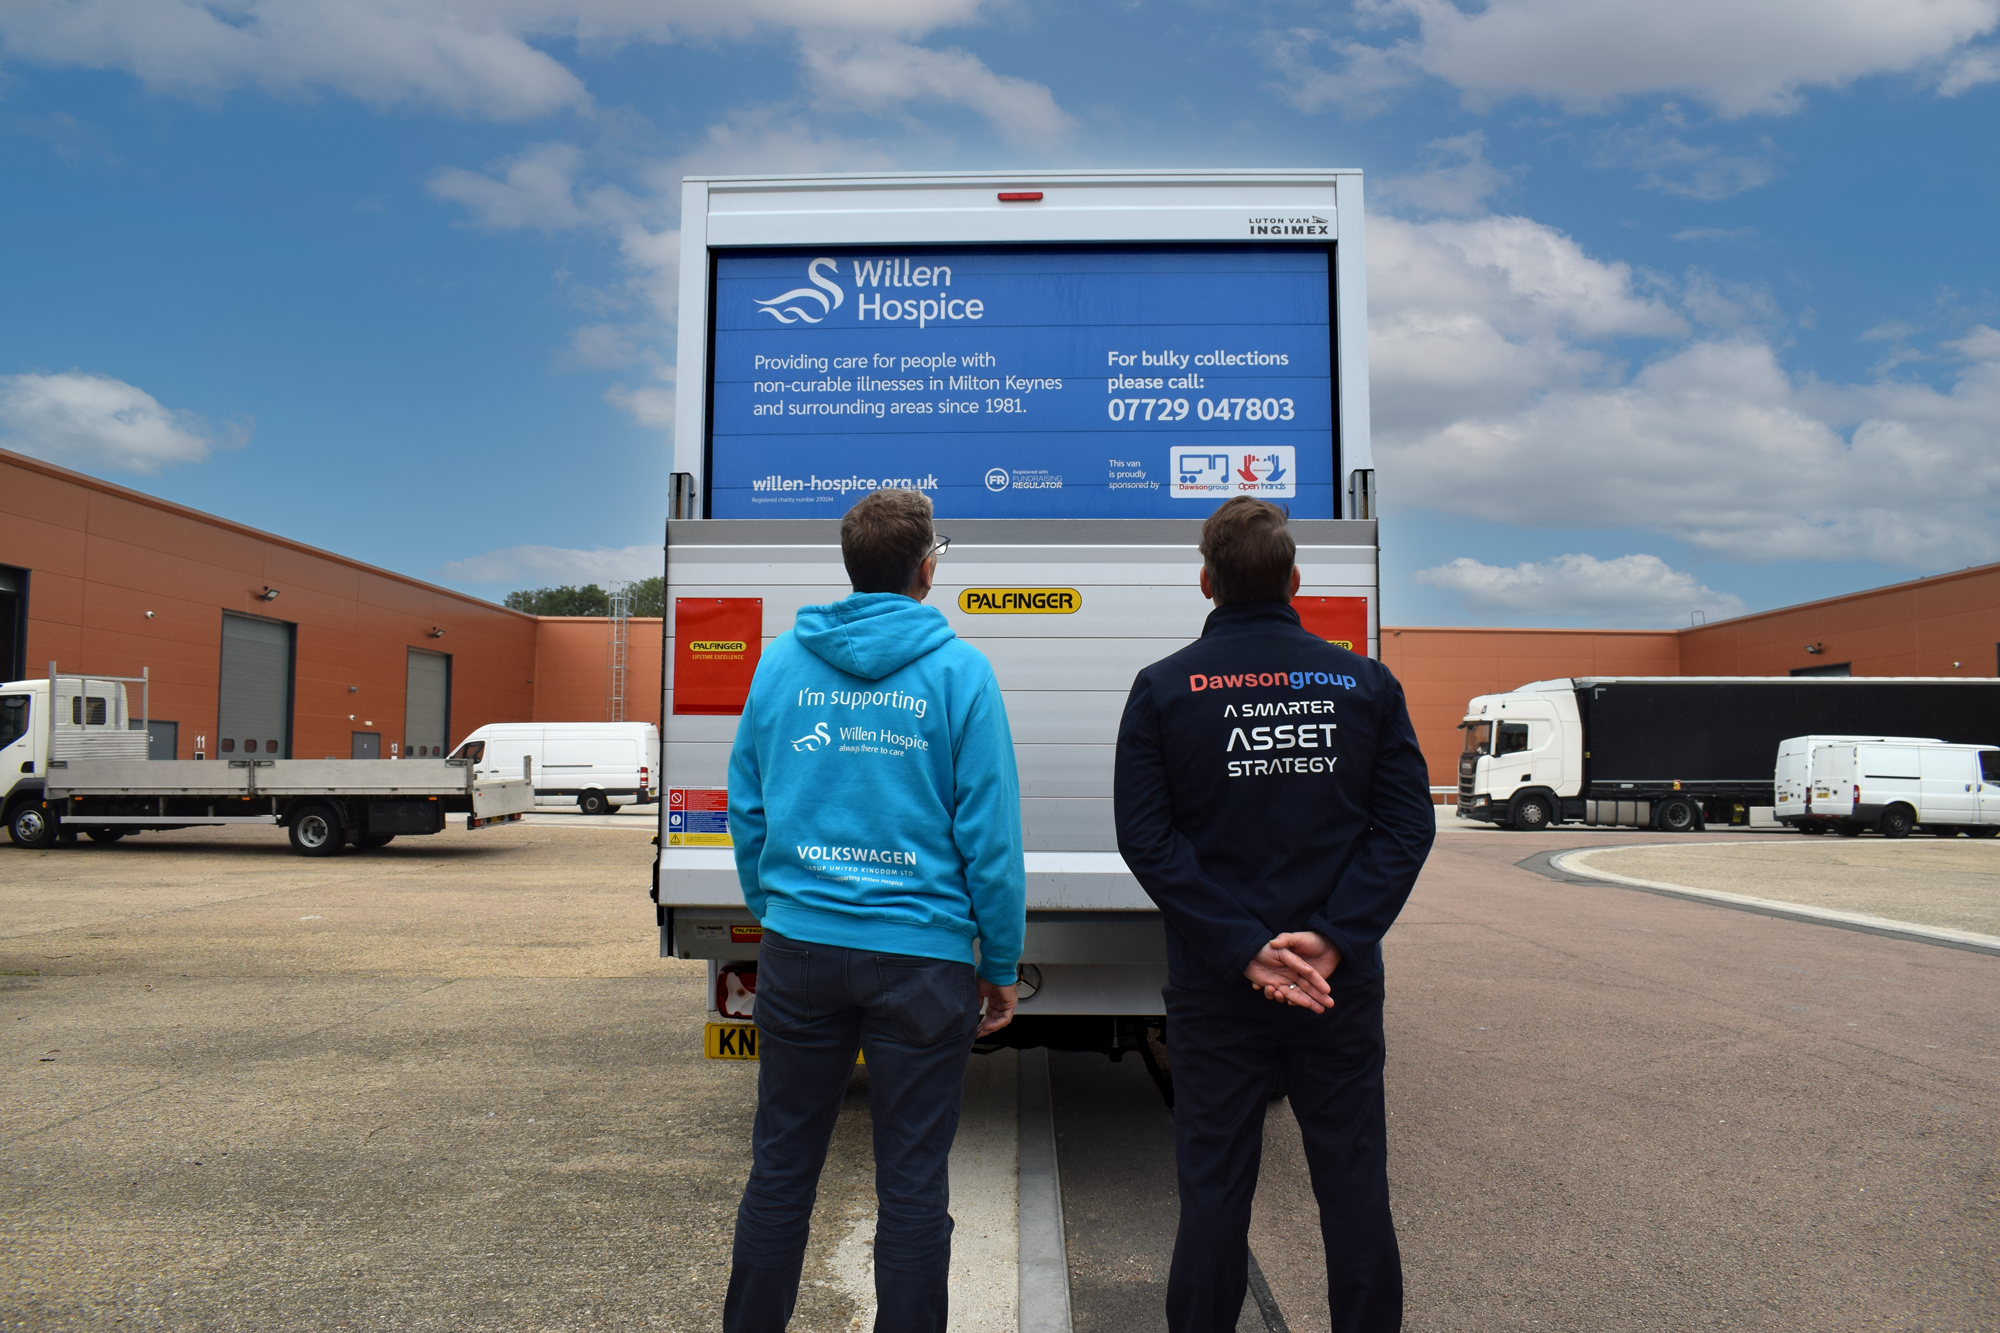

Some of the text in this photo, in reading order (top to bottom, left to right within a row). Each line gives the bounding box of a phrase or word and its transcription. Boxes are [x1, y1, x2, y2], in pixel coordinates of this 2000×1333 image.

[1250, 225, 1329, 235] INGIMEX
[853, 258, 952, 288] Willen
[858, 292, 984, 329] Hospice
[754, 351, 996, 373] Providing care for people with
[1108, 350, 1289, 370] For bulky collections
[753, 375, 1063, 393] non-curable illnesses in Milton Keynes
[1108, 373, 1204, 394] please call:
[753, 398, 1027, 418] and surrounding areas since 1981.
[1108, 397, 1295, 421] 07729 047803
[1108, 459, 1125, 468] This
[752, 473, 939, 495] willen-hospice.org.uk
[989, 475, 1006, 485] FR
[1108, 470, 1146, 480] is proudly
[1012, 481, 1063, 489] REGULATOR
[1108, 481, 1160, 490] sponsored by
[1179, 483, 1229, 491] Dawsongroup
[1238, 482, 1287, 491] Open hands
[778, 496, 795, 504] charity
[967, 593, 1073, 609] PALFINGER
[693, 642, 743, 650] PALFINGER
[1189, 671, 1357, 692] Dawsongroup
[798, 687, 927, 719] I'm supporting
[1224, 700, 1335, 718] A SMARTER
[196, 735, 205, 749] 11
[839, 726, 929, 751] Willen Hospice
[1227, 723, 1337, 752] ASSET
[839, 744, 905, 757] always there to care
[1227, 756, 1338, 777] STRATEGY
[797, 845, 917, 866] VOLKSWAGEN
[861, 867, 898, 875] KINGDOM
[881, 878, 904, 887] Hospice
[719, 1028, 757, 1056] KN
